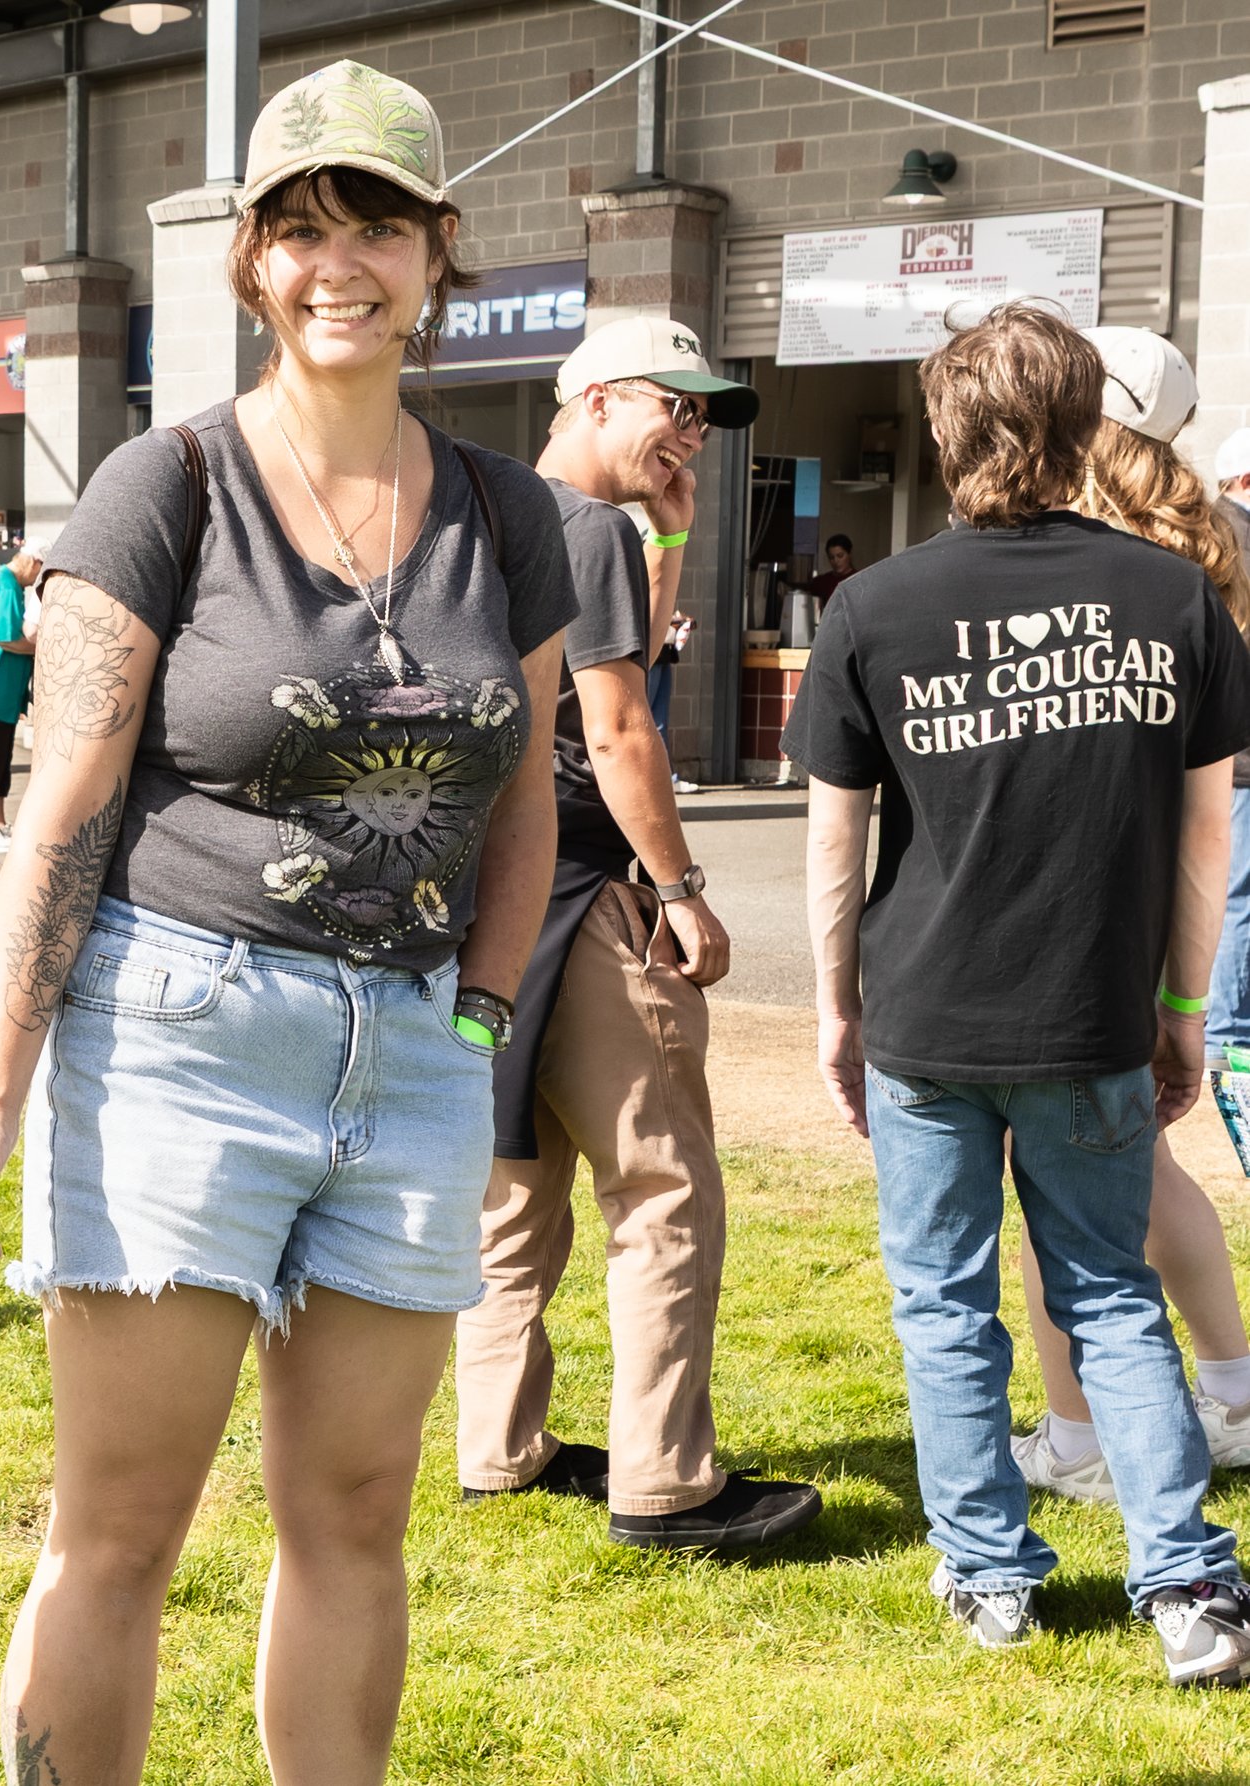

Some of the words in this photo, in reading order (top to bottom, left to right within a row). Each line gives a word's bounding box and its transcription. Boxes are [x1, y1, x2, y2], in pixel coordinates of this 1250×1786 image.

[905, 261, 967, 273] ESPRESSO
[954, 620, 973, 661] I
[901, 673, 973, 711] MY
[986, 638, 1178, 698] COUGAR
[902, 685, 1178, 755] GIRLFRIEND
